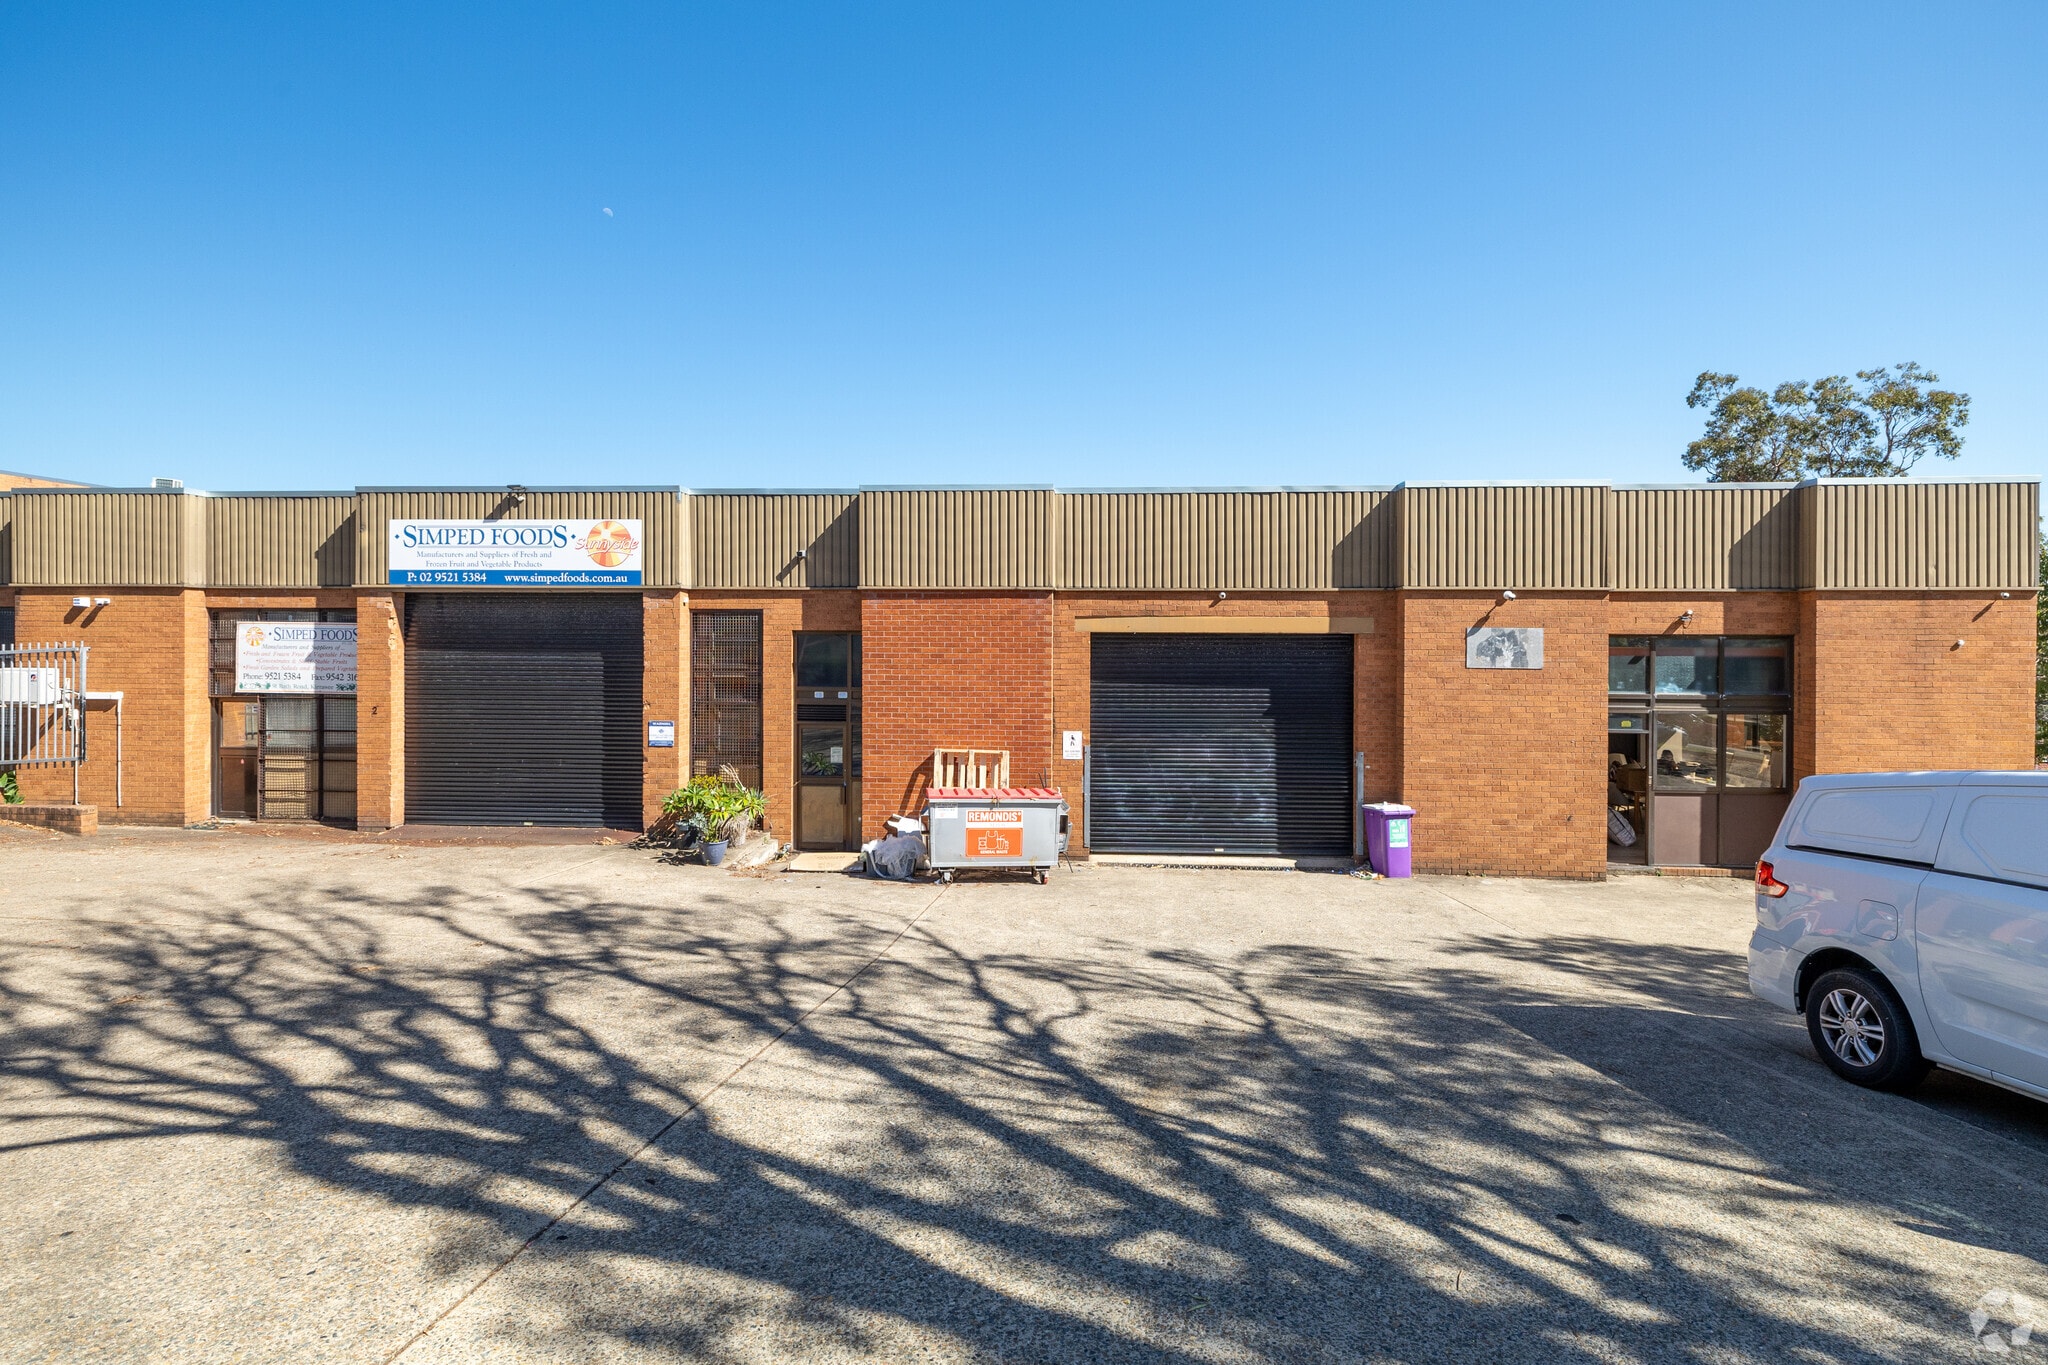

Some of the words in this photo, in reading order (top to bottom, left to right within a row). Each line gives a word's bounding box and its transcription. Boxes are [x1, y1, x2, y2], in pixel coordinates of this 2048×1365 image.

[403, 524, 484, 548] SIMPED
[492, 524, 567, 548] FOODS
[575, 537, 640, 553] Sunnyside
[480, 550, 510, 559] Suppliers
[481, 560, 512, 569] Vegetable
[407, 572, 417, 582] P:
[420, 572, 432, 582] 02
[435, 572, 458, 582] 9521
[462, 572, 486, 582] 5384
[505, 572, 628, 584] www.simpedfoods.com.au
[274, 626, 317, 641] SIMPED
[326, 673, 344, 681] 9542
[372, 706, 378, 715] 2
[968, 811, 1018, 821] REMONDIS
